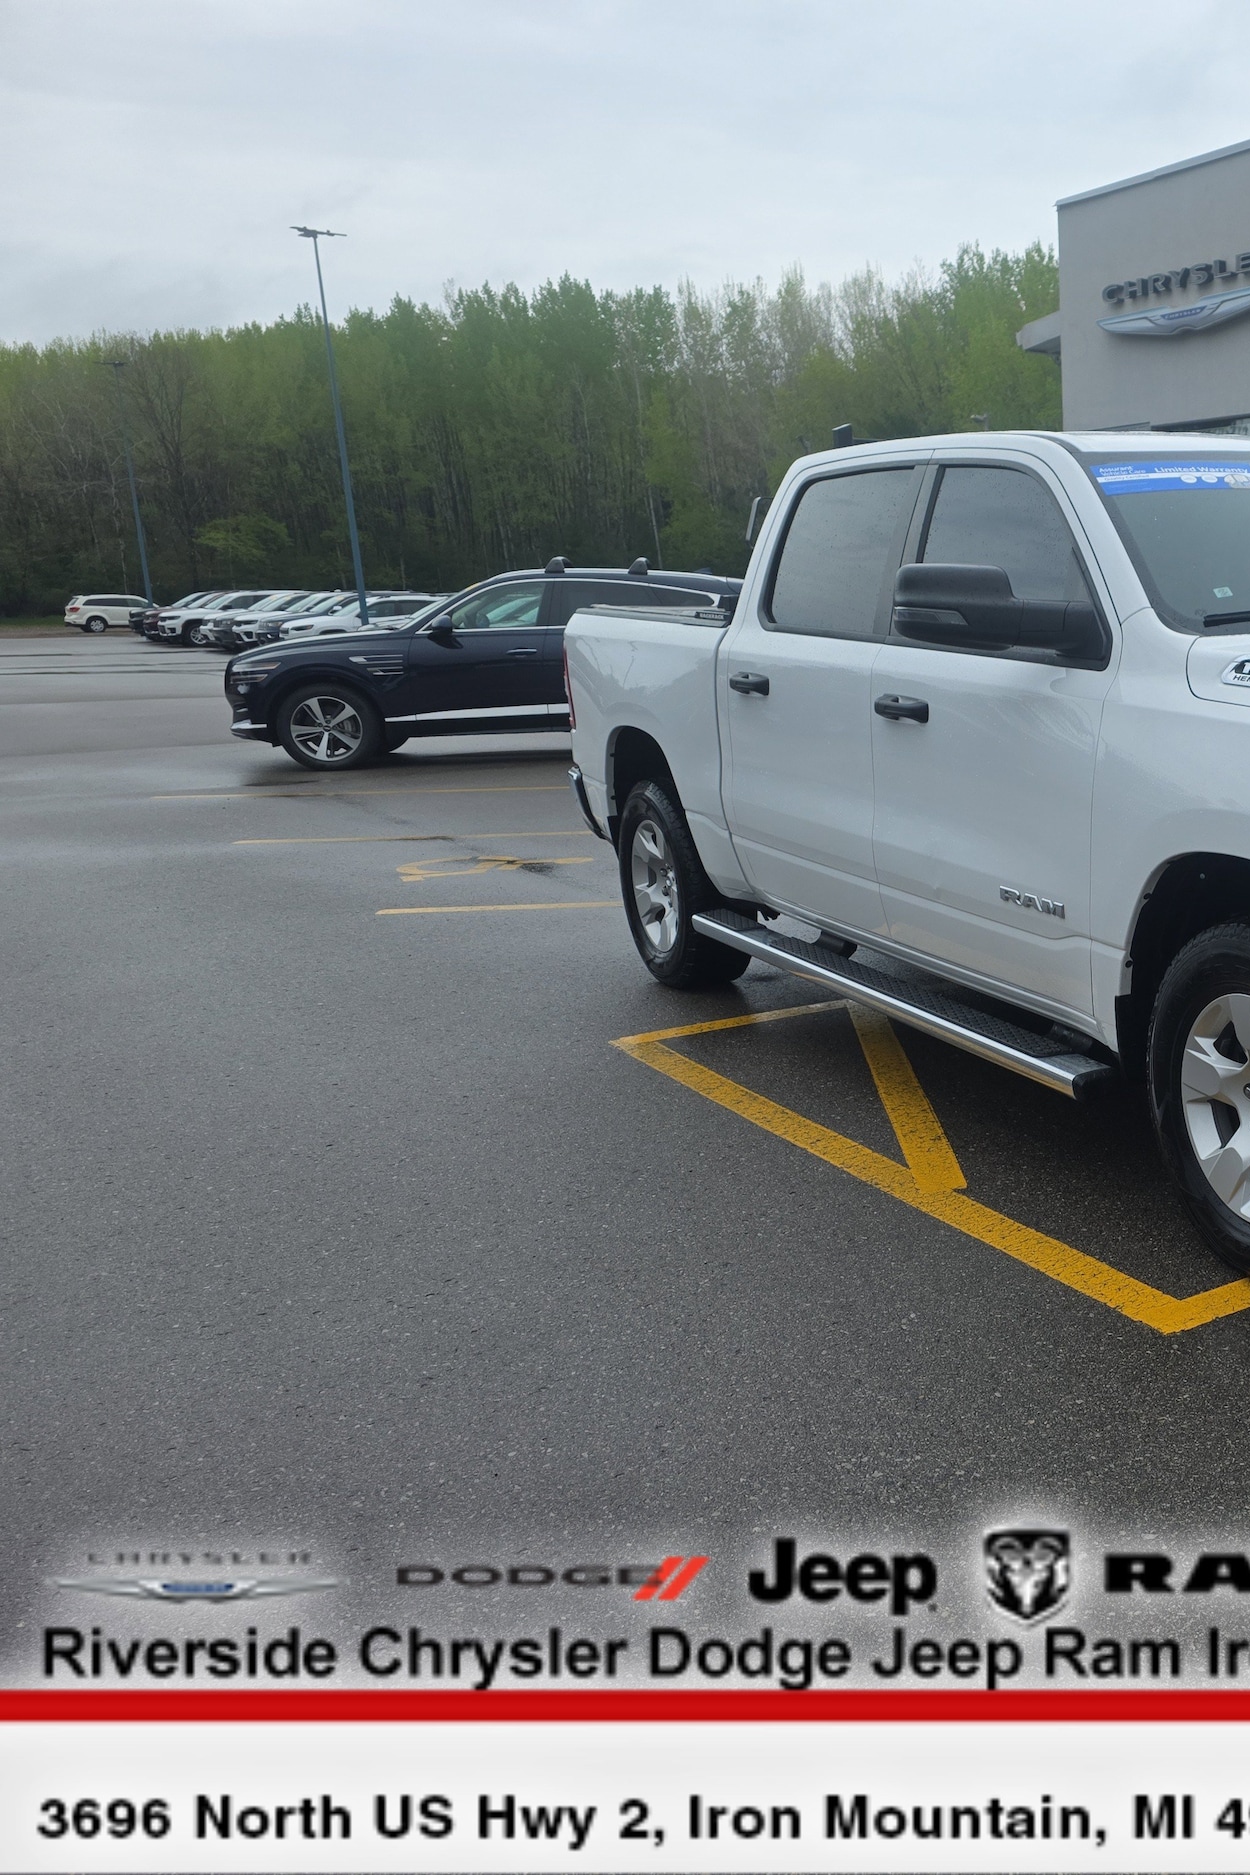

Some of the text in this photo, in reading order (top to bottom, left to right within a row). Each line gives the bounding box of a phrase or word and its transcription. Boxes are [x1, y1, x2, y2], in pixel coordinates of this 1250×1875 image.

[1154, 466, 1248, 475] Limited Warranty
[999, 885, 1066, 920] RAM
